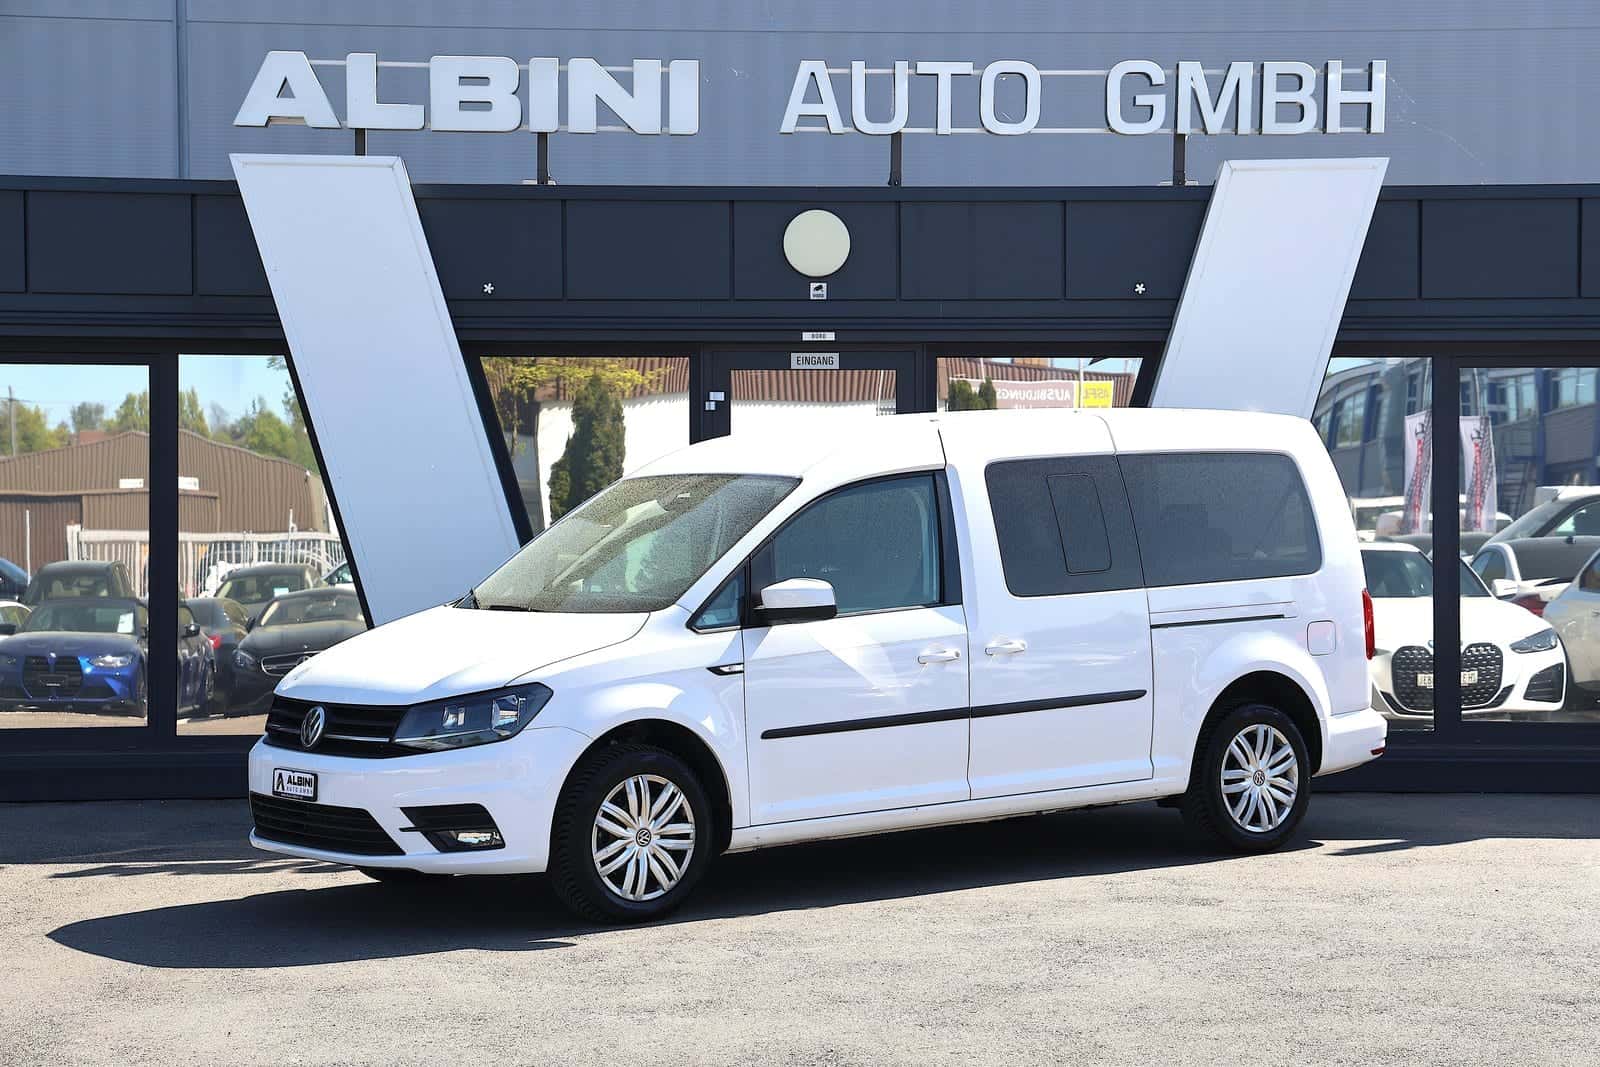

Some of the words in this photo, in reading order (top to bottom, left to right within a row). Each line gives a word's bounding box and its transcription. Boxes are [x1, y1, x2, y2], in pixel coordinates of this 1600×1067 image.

[233, 51, 700, 136] ALBINI
[780, 59, 1041, 136] AUTO
[1106, 59, 1387, 136] GMBH
[796, 355, 834, 366] EINGANG
[287, 774, 313, 788] ALBINI
